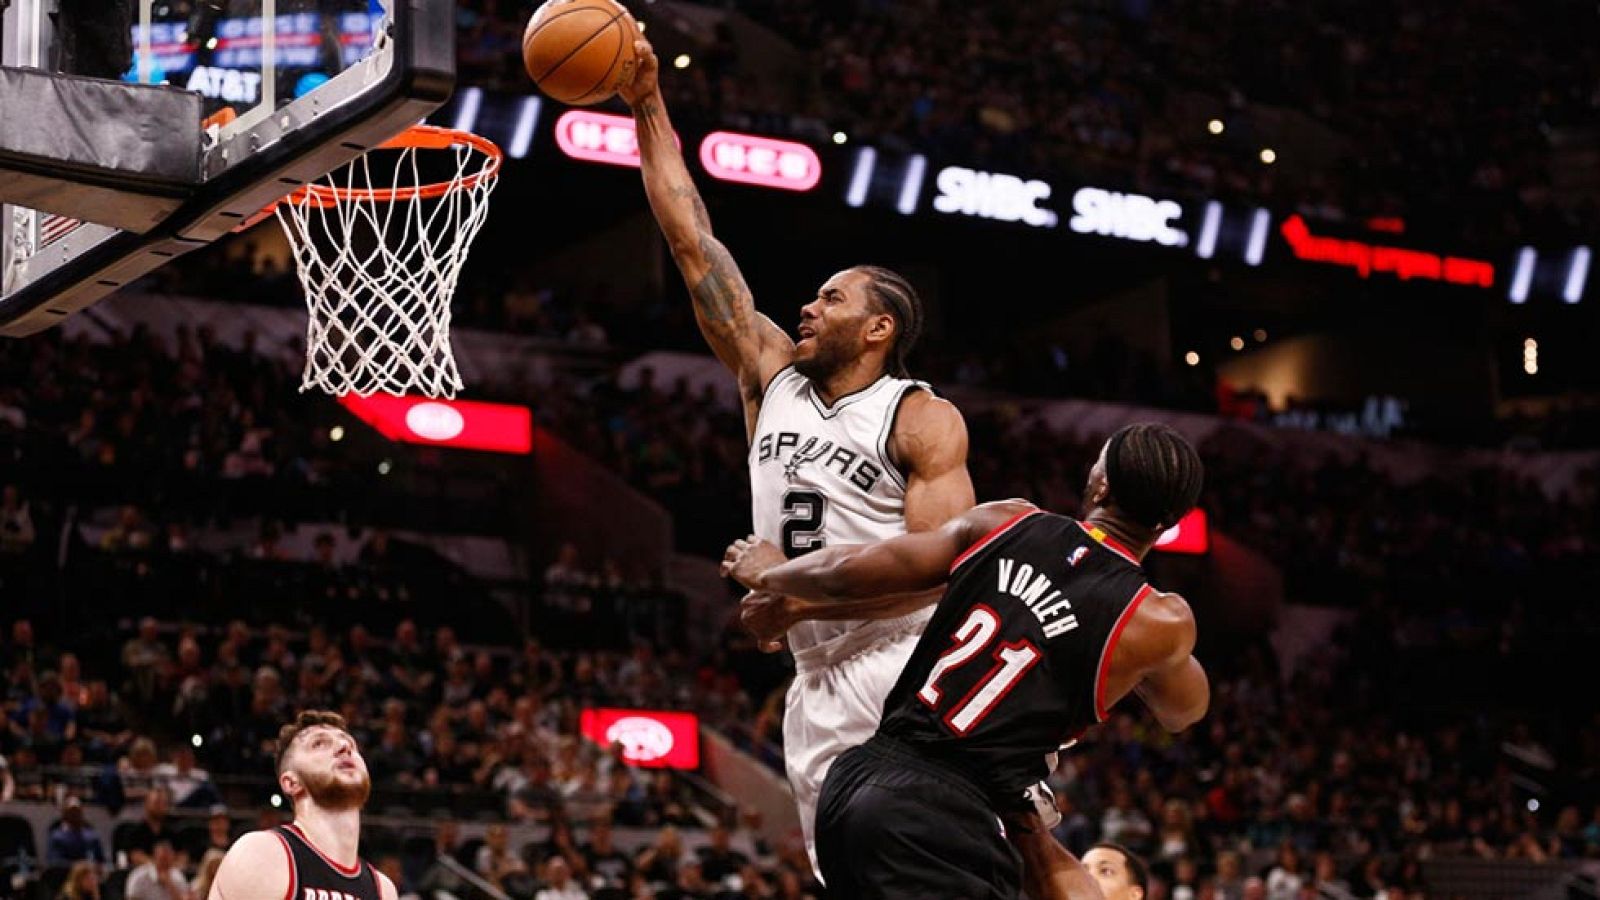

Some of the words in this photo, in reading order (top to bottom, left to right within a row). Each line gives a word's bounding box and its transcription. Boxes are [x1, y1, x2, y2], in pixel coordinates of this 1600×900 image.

[187, 66, 262, 103] AT&T
[758, 432, 882, 494] SPURS
[781, 486, 828, 560] 2
[997, 557, 1080, 640] VONLEH
[916, 602, 1044, 738] 21
